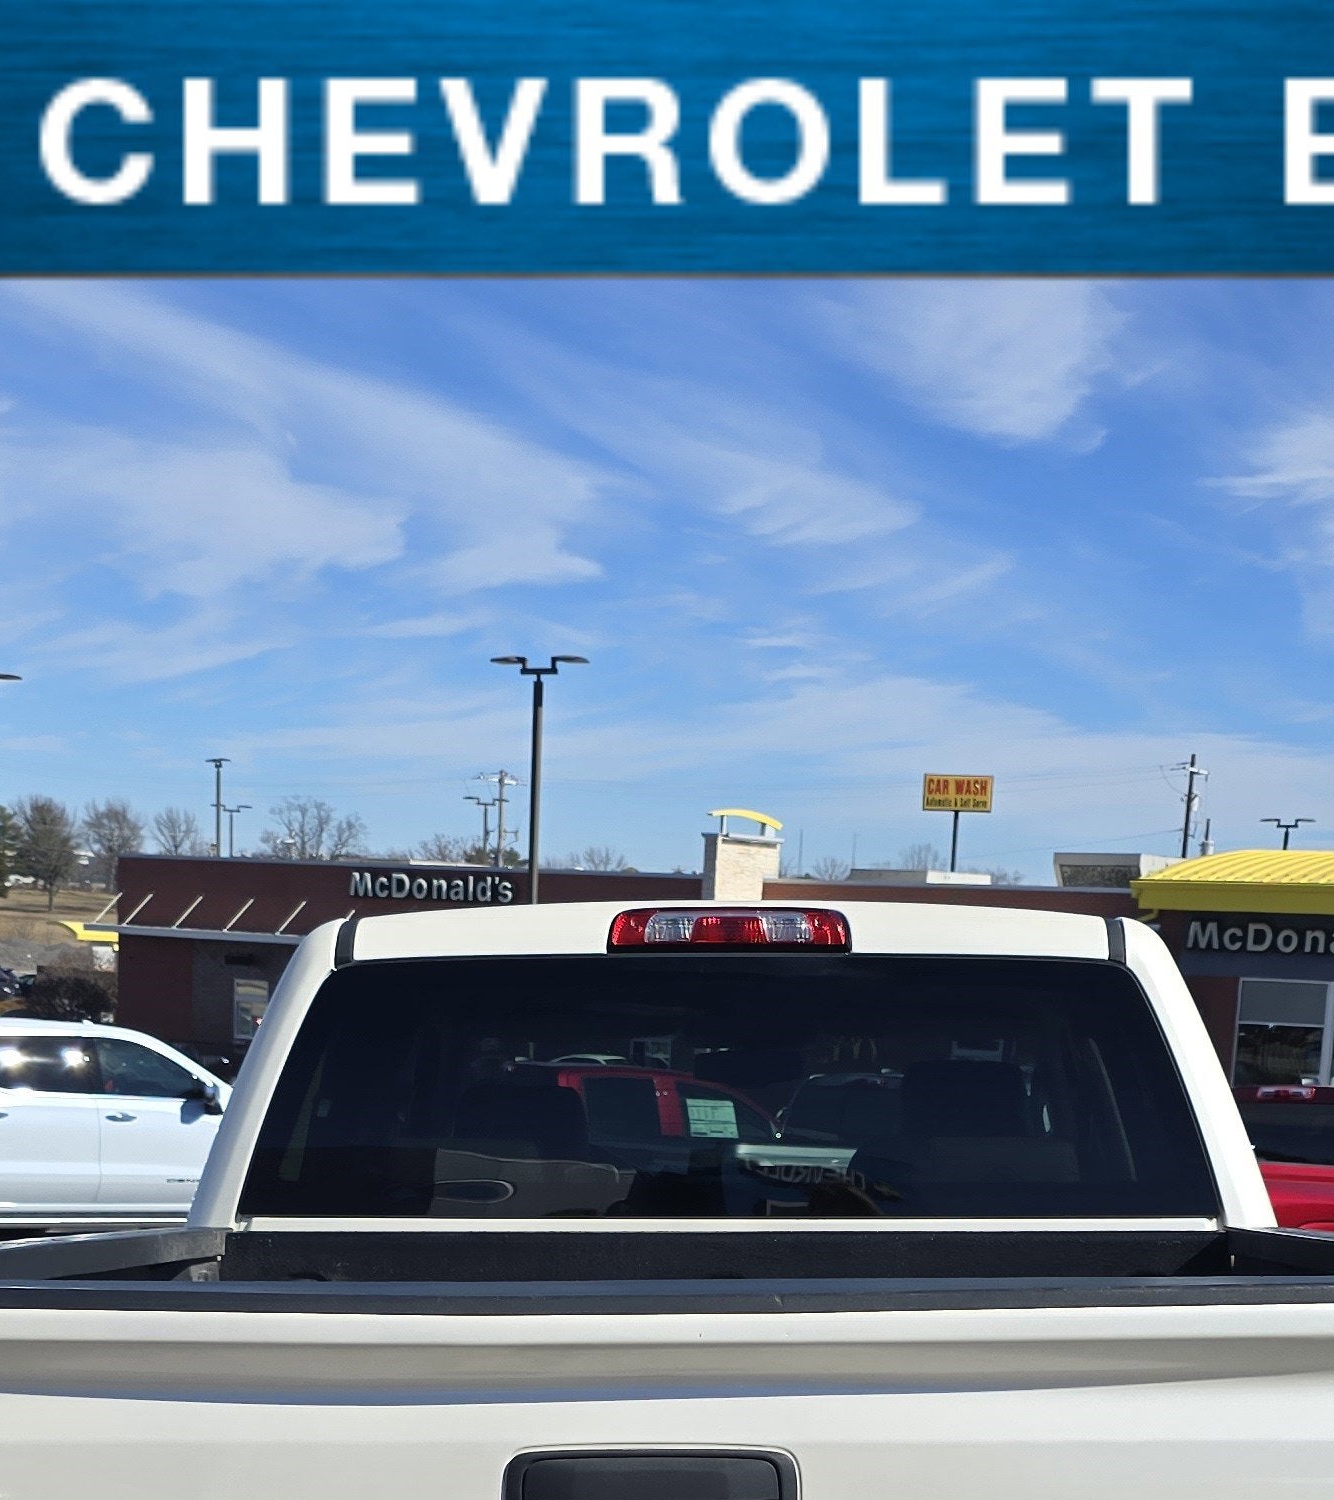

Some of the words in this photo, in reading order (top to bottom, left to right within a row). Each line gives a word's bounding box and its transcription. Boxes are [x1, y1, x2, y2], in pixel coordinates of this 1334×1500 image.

[927, 779, 949, 795] CAR
[955, 779, 988, 796] WASH
[349, 872, 513, 902] McDonald's
